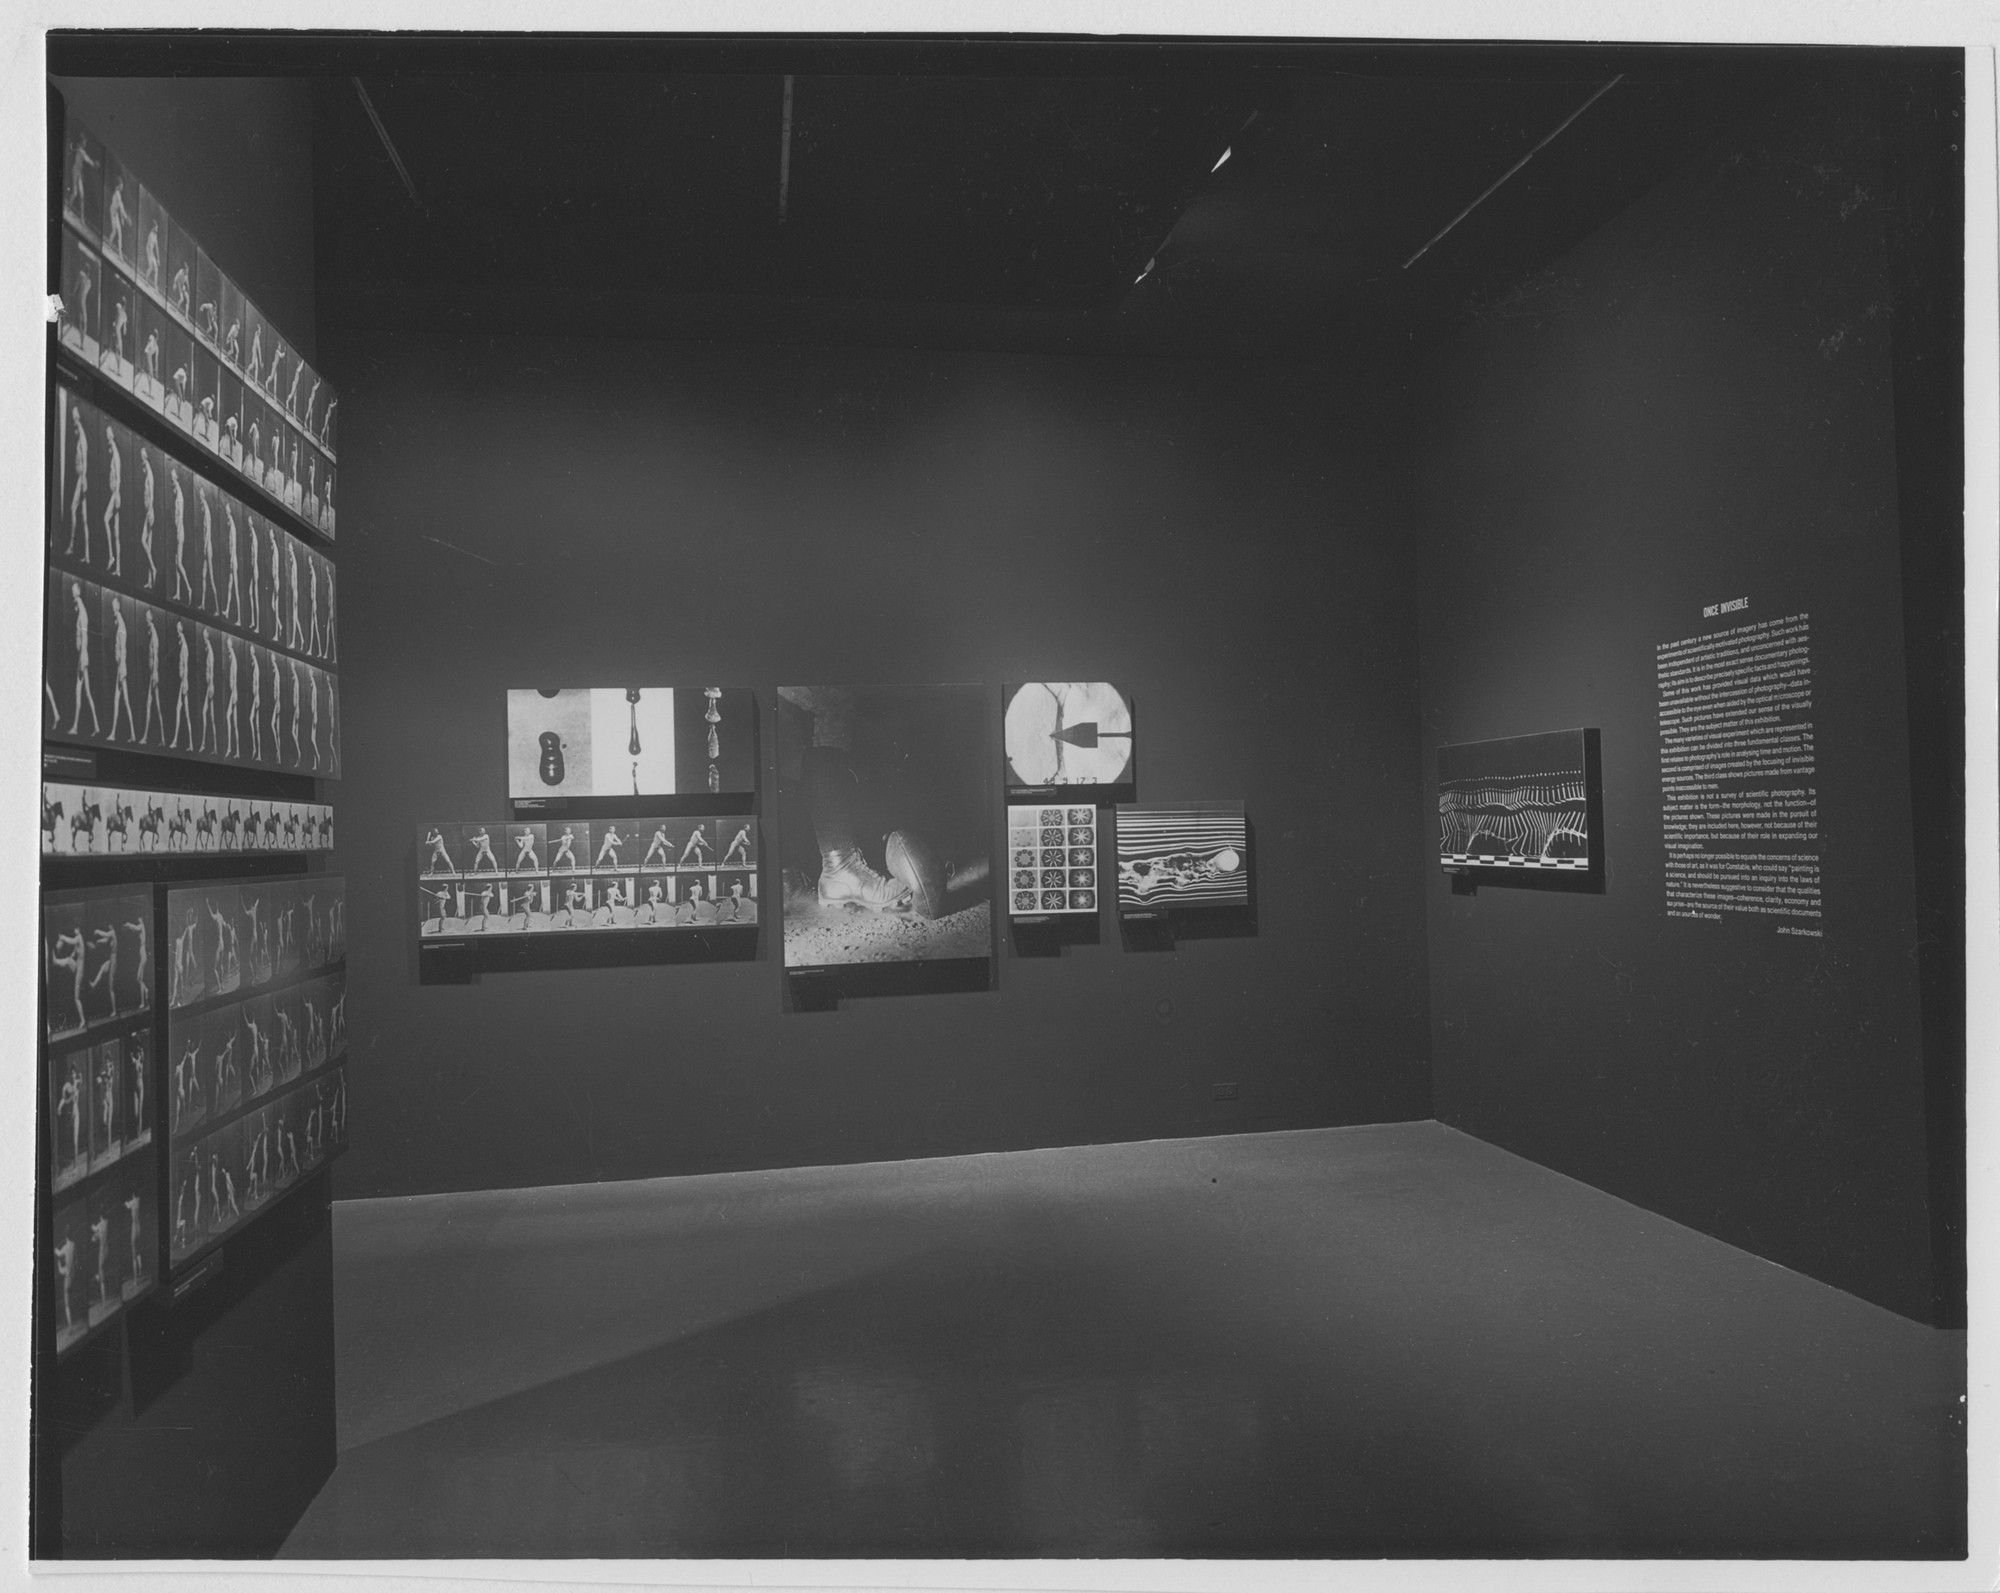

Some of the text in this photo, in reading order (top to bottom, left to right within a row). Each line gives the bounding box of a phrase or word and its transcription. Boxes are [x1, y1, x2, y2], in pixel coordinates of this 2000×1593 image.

[1703, 596, 1749, 618] ONCE INVISIBLE
[1758, 621, 1768, 629] has
[1769, 618, 1784, 627] come
[1785, 614, 1798, 624] from
[1799, 612, 1808, 621] the
[1738, 623, 1809, 645] photography. Such work has
[1751, 639, 1784, 652] unconcerned
[1785, 637, 1796, 645] with
[1797, 635, 1809, 643] aes-
[1754, 649, 1788, 663] documentary
[1788, 645, 1809, 657] photog-
[1754, 664, 1767, 672] facts
[1767, 662, 1777, 670] and
[1777, 656, 1810, 670] happenings.
[1750, 675, 1761, 683] data
[1762, 672, 1778, 681] which
[1779, 669, 1796, 678] would
[1797, 667, 1811, 675] have
[1803, 678, 1811, 686] in-
[1756, 694, 1773, 705] optical
[1774, 690, 1805, 702] microscope
[1791, 700, 1812, 710] visually
[1754, 714, 1781, 724] exhibition.
[1750, 727, 1765, 735] which
[1775, 722, 1807, 734] represented
[1747, 736, 1779, 745] fundamental
[1780, 734, 1801, 742] classes.
[1803, 732, 1814, 740] The
[1760, 747, 1771, 755] time
[1772, 746, 1782, 754] and
[1783, 744, 1802, 753] motion.
[1803, 743, 1814, 751] The
[1762, 757, 1785, 767] focusing
[1792, 754, 1815, 763] invisible
[1793, 765, 1815, 775] vantage
[1770, 788, 1806, 797] photography.
[1789, 810, 1809, 818] pursuit
[1778, 832, 1807, 840] expanding
[1759, 874, 1777, 883] inquiry
[1753, 884, 1775, 892] consider
[1797, 886, 1821, 895] qualities
[1784, 897, 1809, 906] economy
[1767, 906, 1790, 914] scientific
[1791, 907, 1822, 916] documents
[1777, 926, 1823, 937] John Szarkowski
